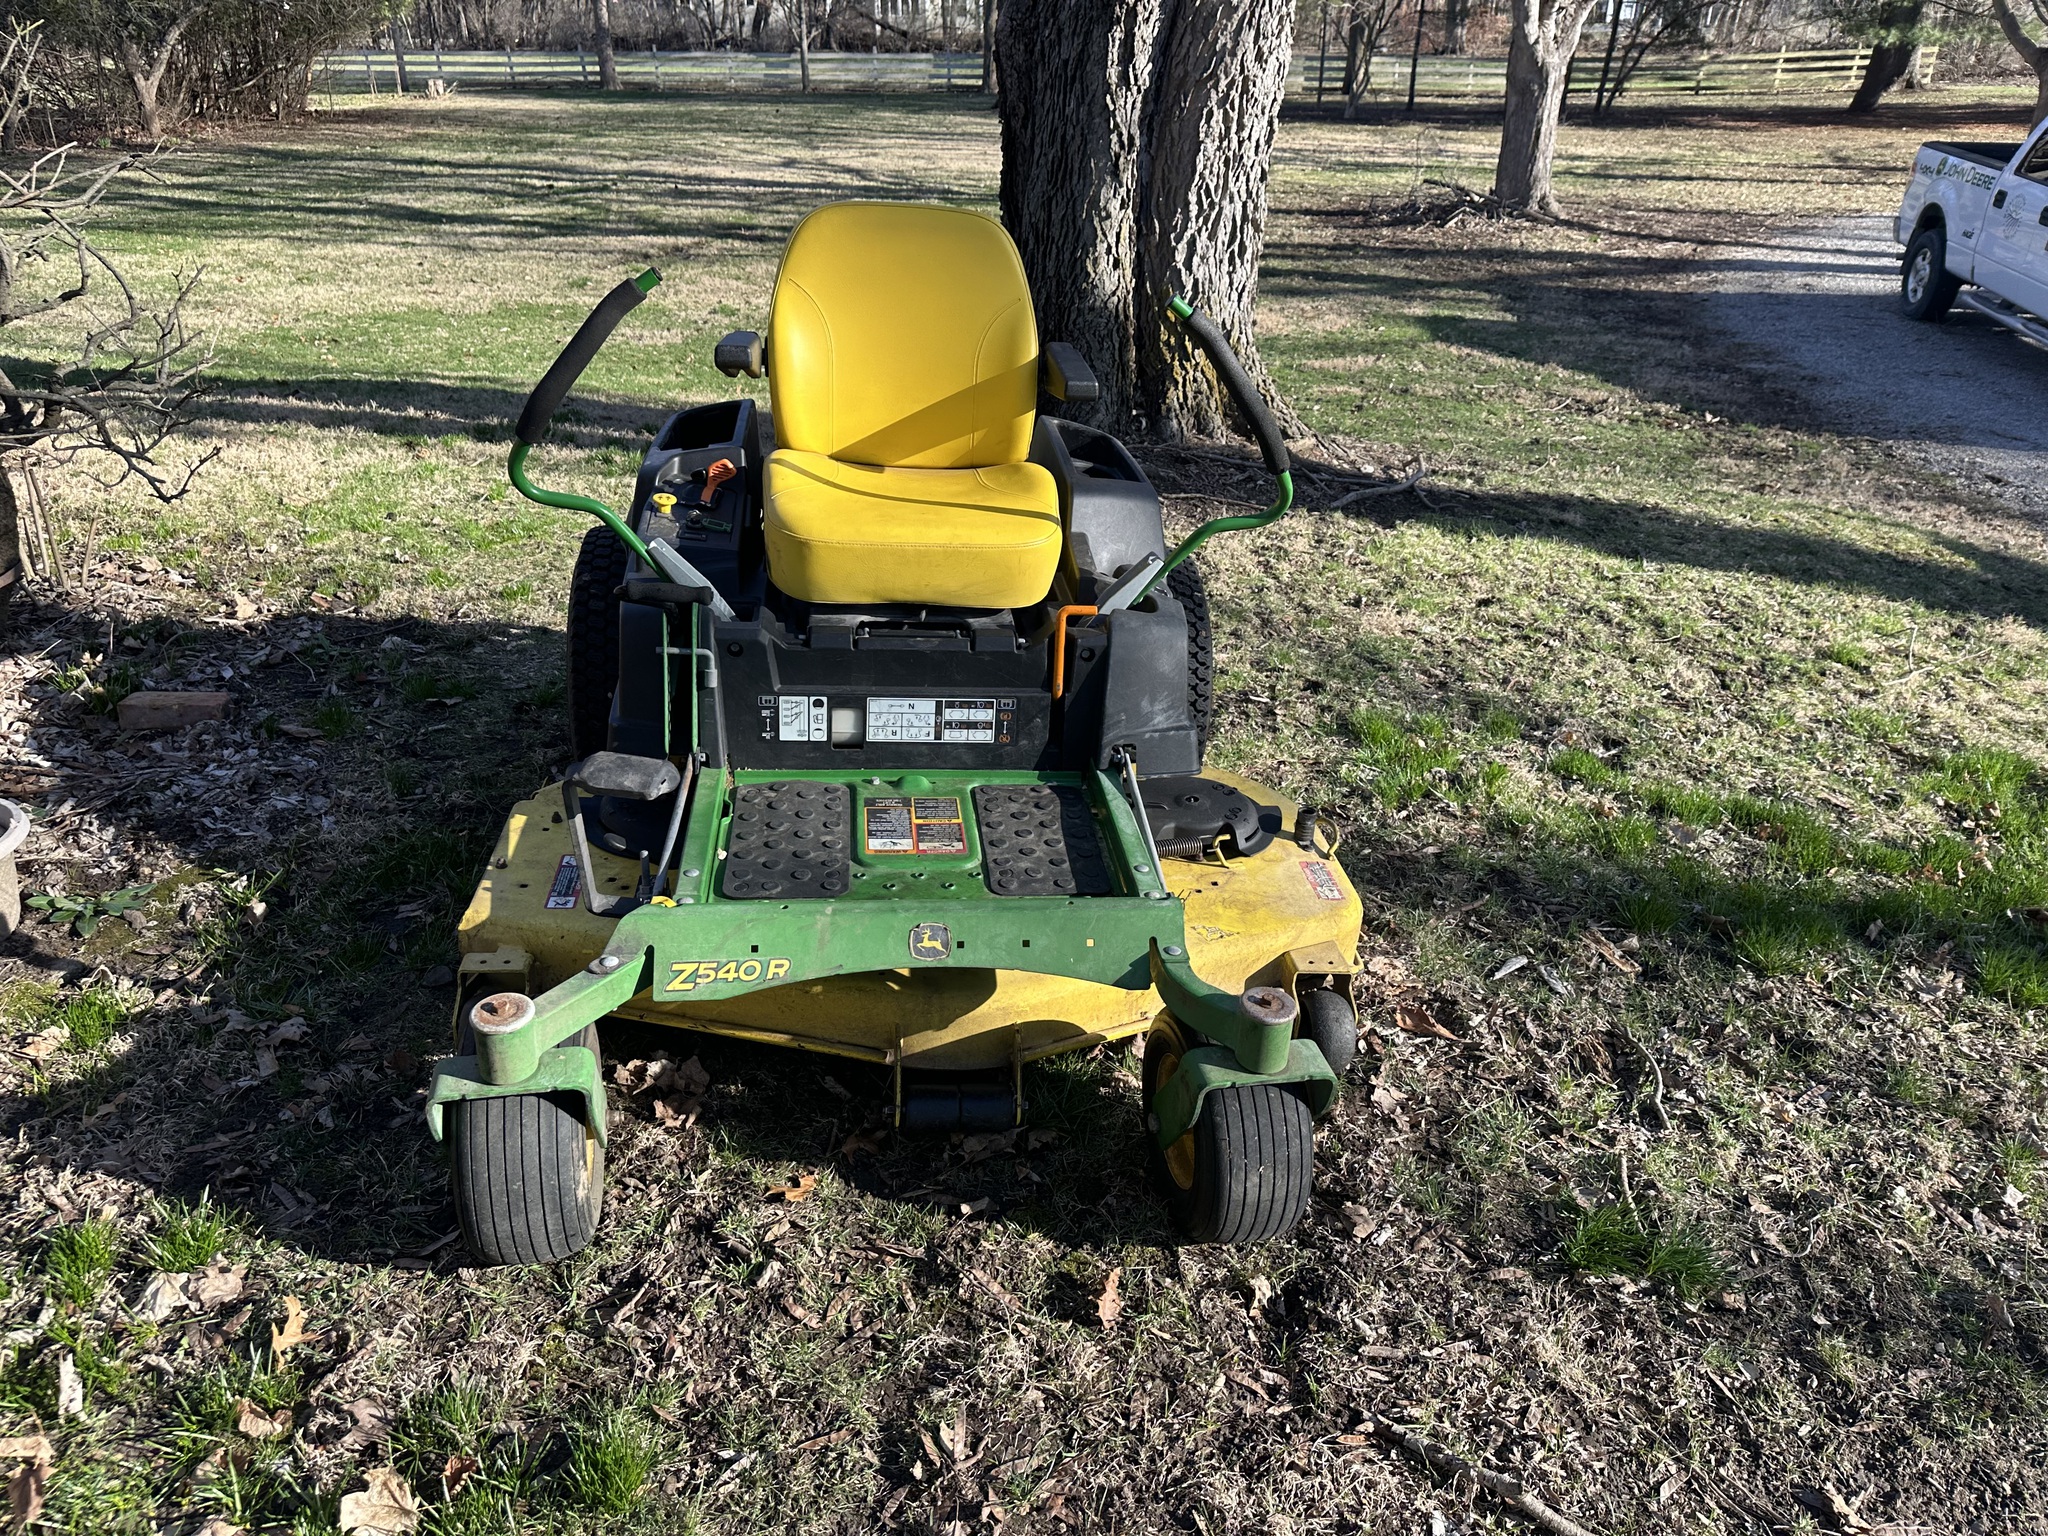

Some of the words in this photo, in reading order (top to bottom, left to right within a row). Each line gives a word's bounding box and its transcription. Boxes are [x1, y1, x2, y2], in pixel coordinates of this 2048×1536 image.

[1943, 161, 1968, 181] JOHN
[1965, 166, 1997, 191] DEERE
[664, 959, 762, 992] Z540
[765, 957, 791, 980] R
